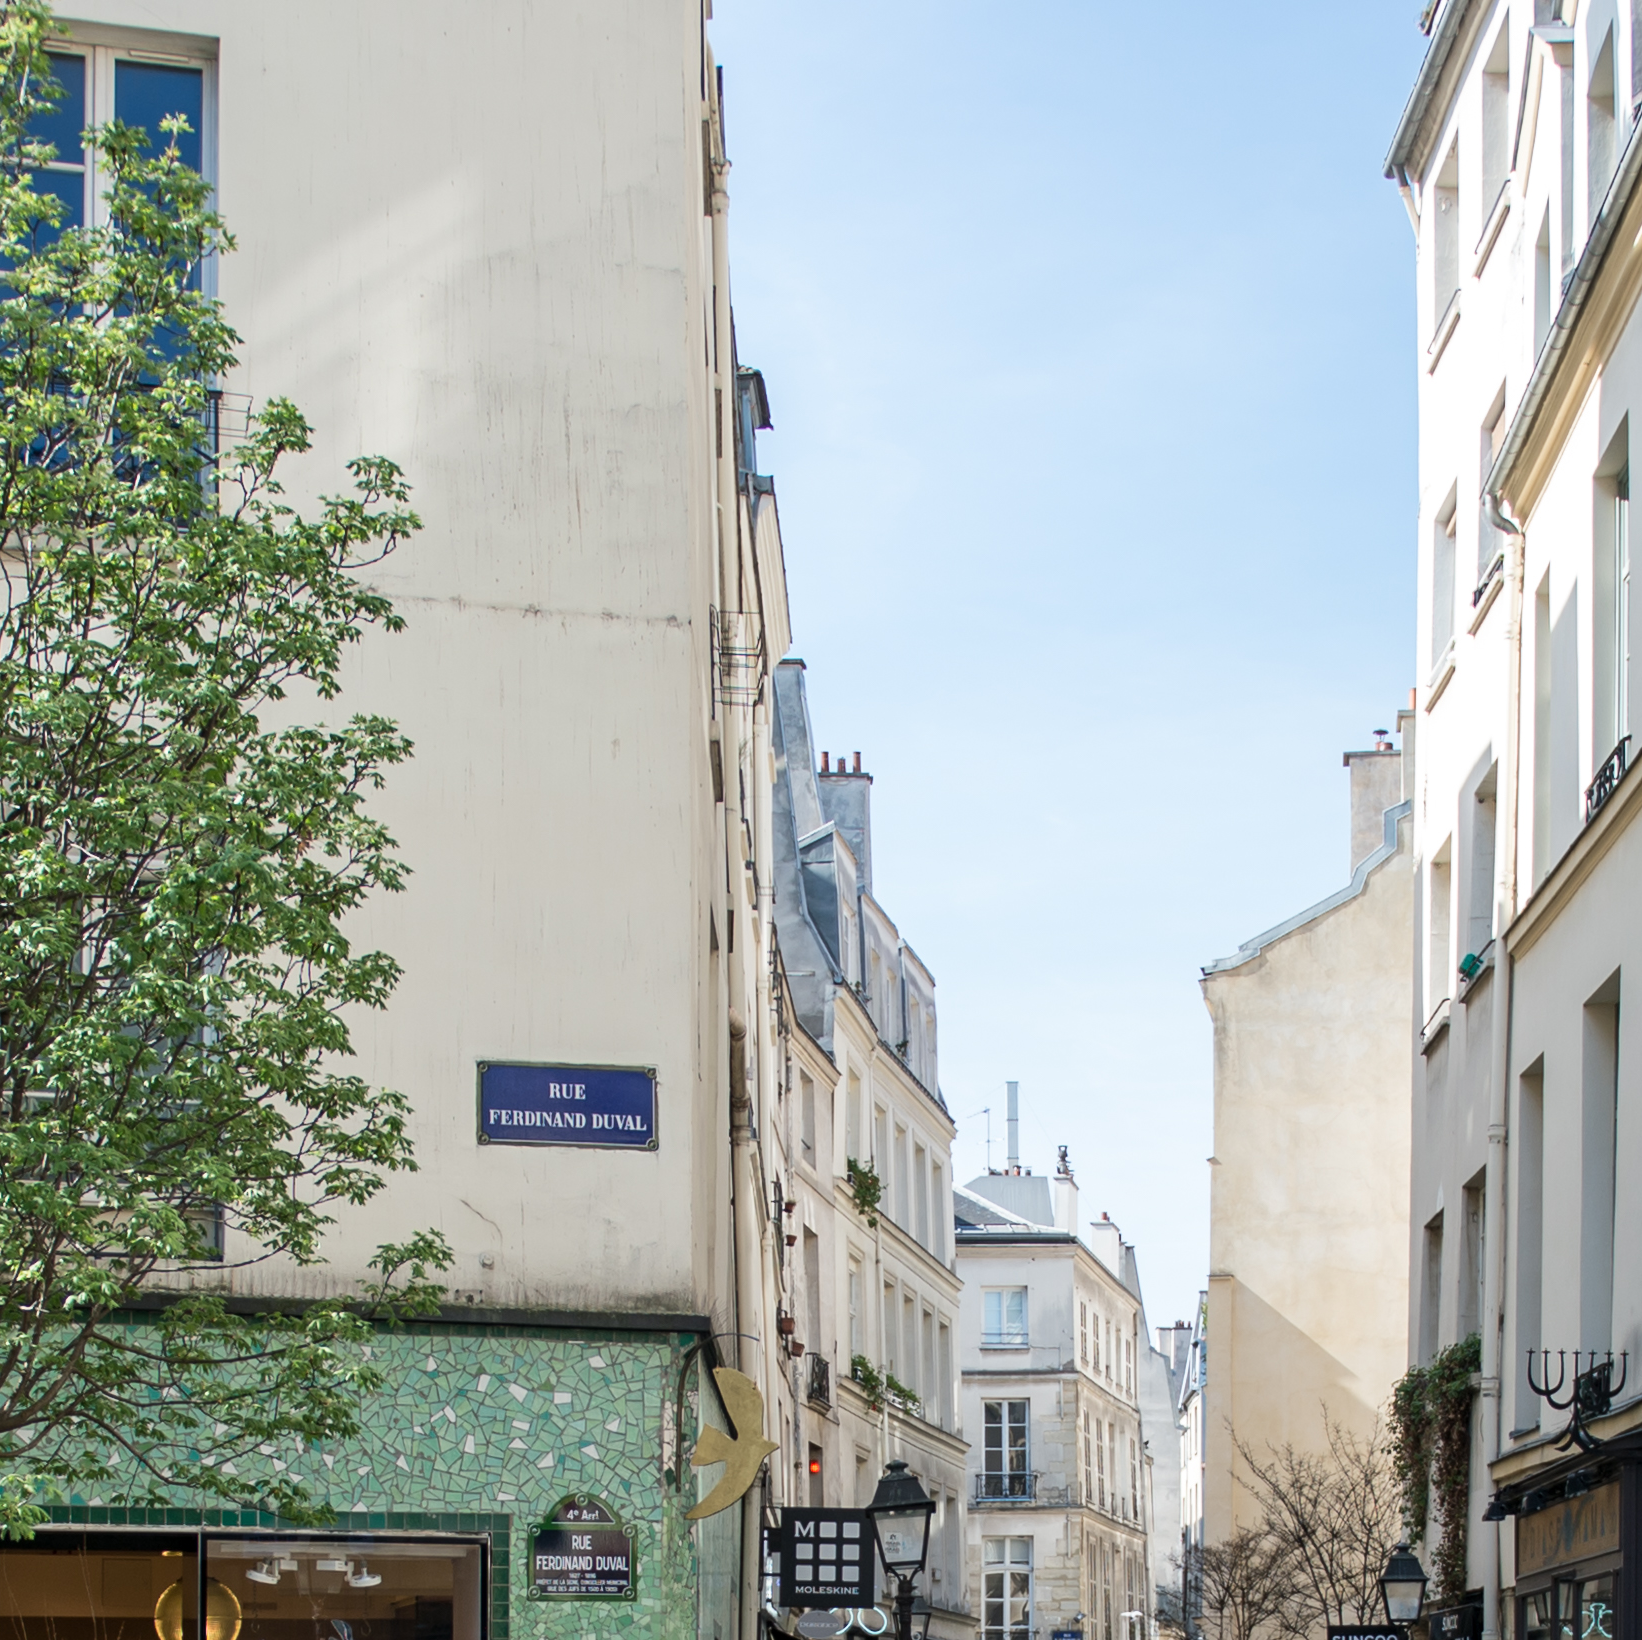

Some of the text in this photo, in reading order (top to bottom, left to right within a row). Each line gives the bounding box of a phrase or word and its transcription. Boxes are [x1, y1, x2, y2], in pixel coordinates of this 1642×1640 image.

[549, 1082, 586, 1100] RUE
[489, 1109, 647, 1131] FERDINAND DUVAL
[572, 1535, 592, 1550] RUE
[536, 1556, 629, 1571] FERDINAND DUVAL
[795, 1586, 860, 1595] MOLESKINE
